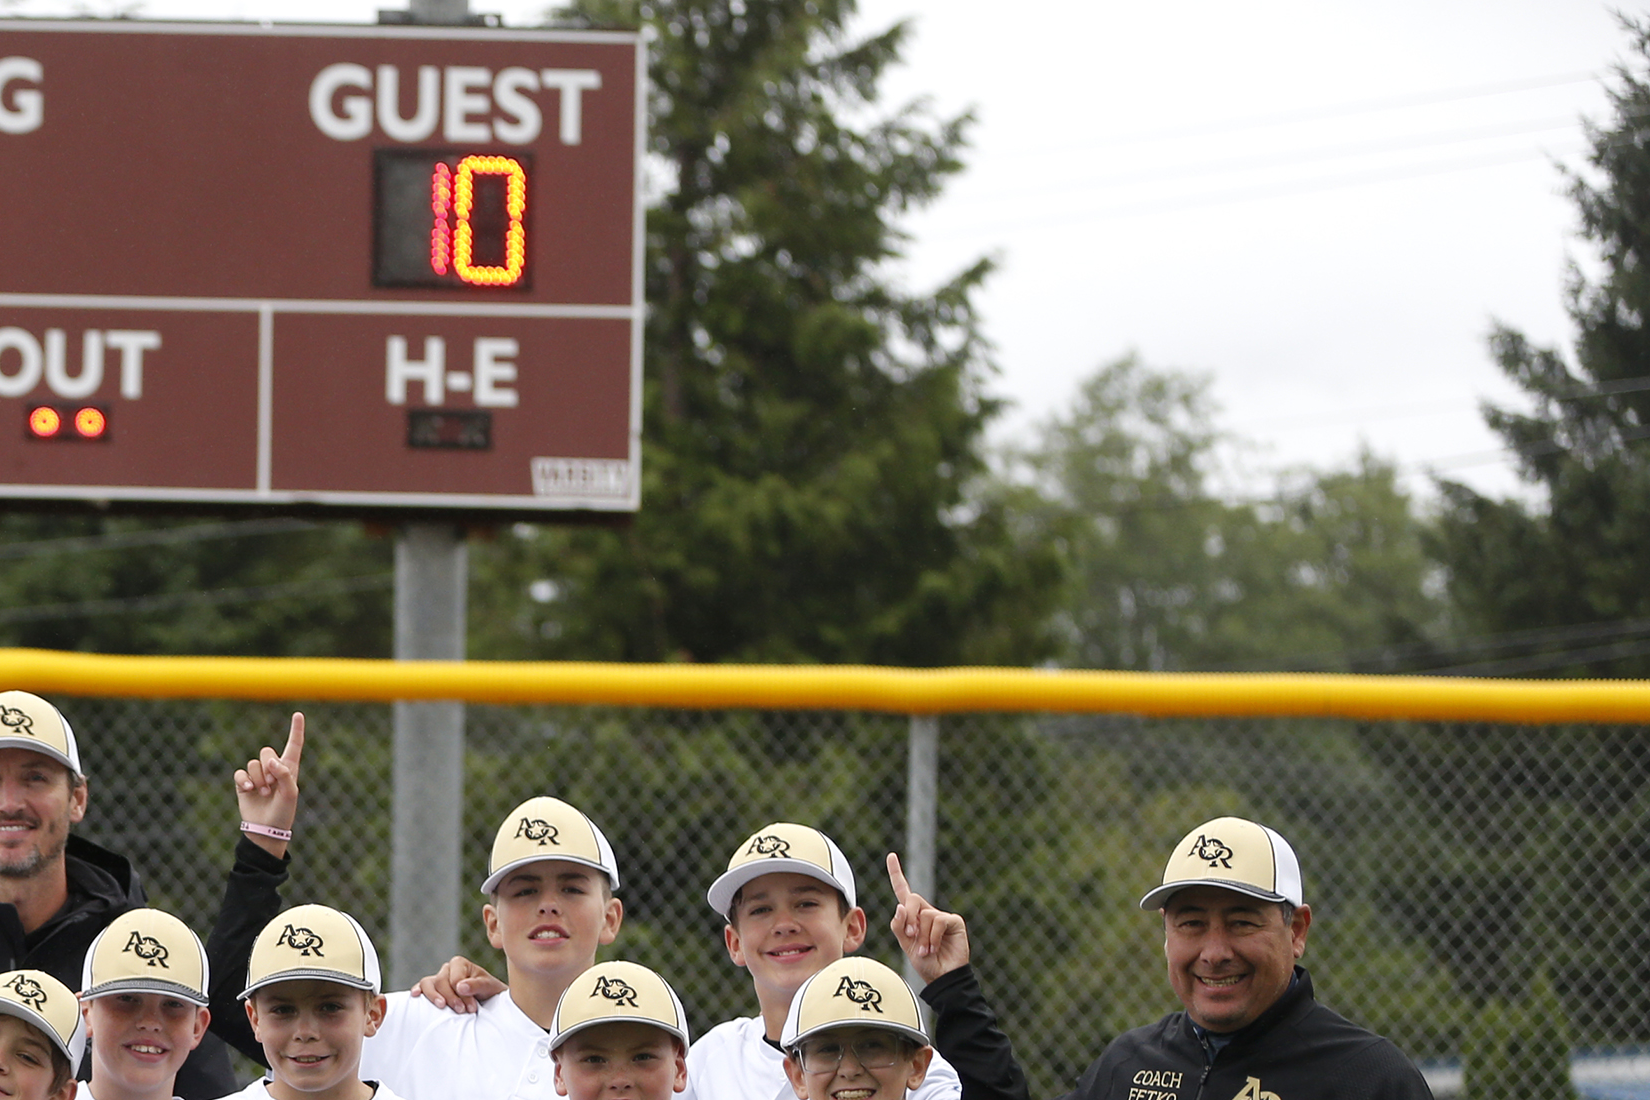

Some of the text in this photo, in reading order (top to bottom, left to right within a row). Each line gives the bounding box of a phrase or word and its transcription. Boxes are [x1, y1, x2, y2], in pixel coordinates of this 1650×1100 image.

[308, 62, 602, 145] GUEST
[430, 154, 526, 286] 10
[385, 335, 520, 407] H-E
[1131, 1069, 1184, 1090] COACH
